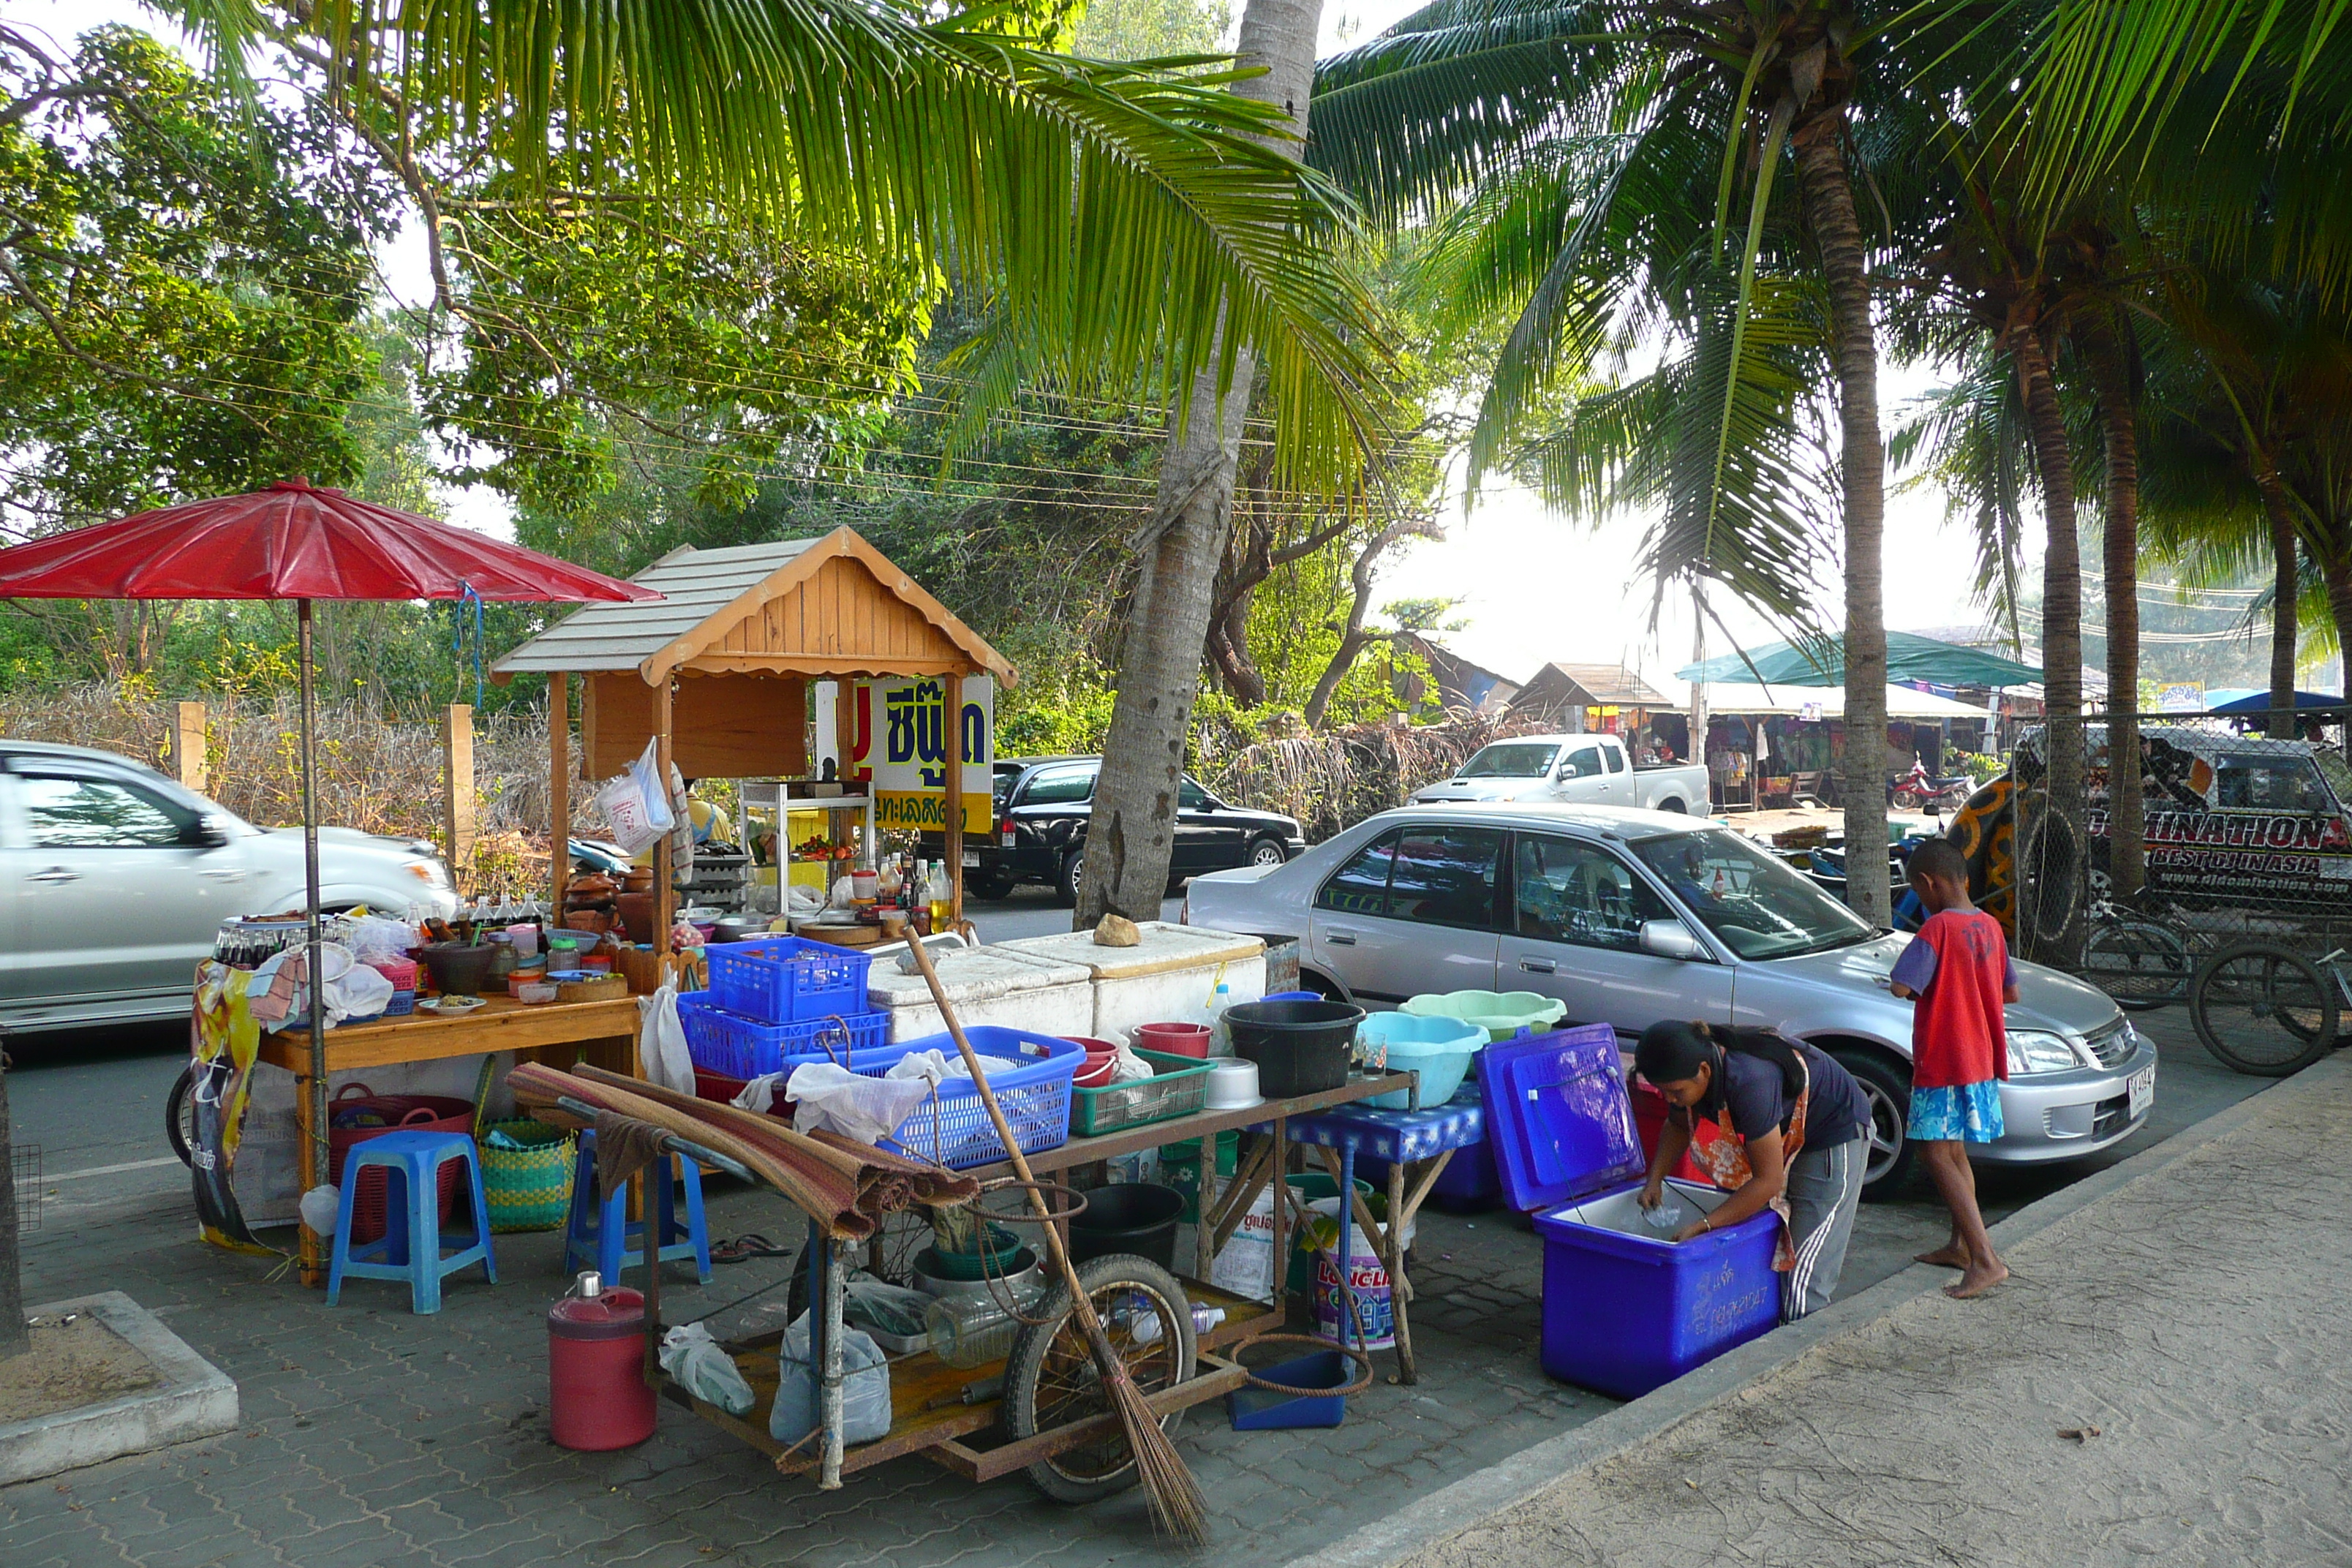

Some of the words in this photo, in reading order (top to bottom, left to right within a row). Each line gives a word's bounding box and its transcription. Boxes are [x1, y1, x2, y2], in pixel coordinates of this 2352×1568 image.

[2152, 848, 2210, 868] BEST
[2209, 851, 2238, 870] DJ
[2239, 852, 2266, 872] IN
[2266, 854, 2321, 876] ASIA
